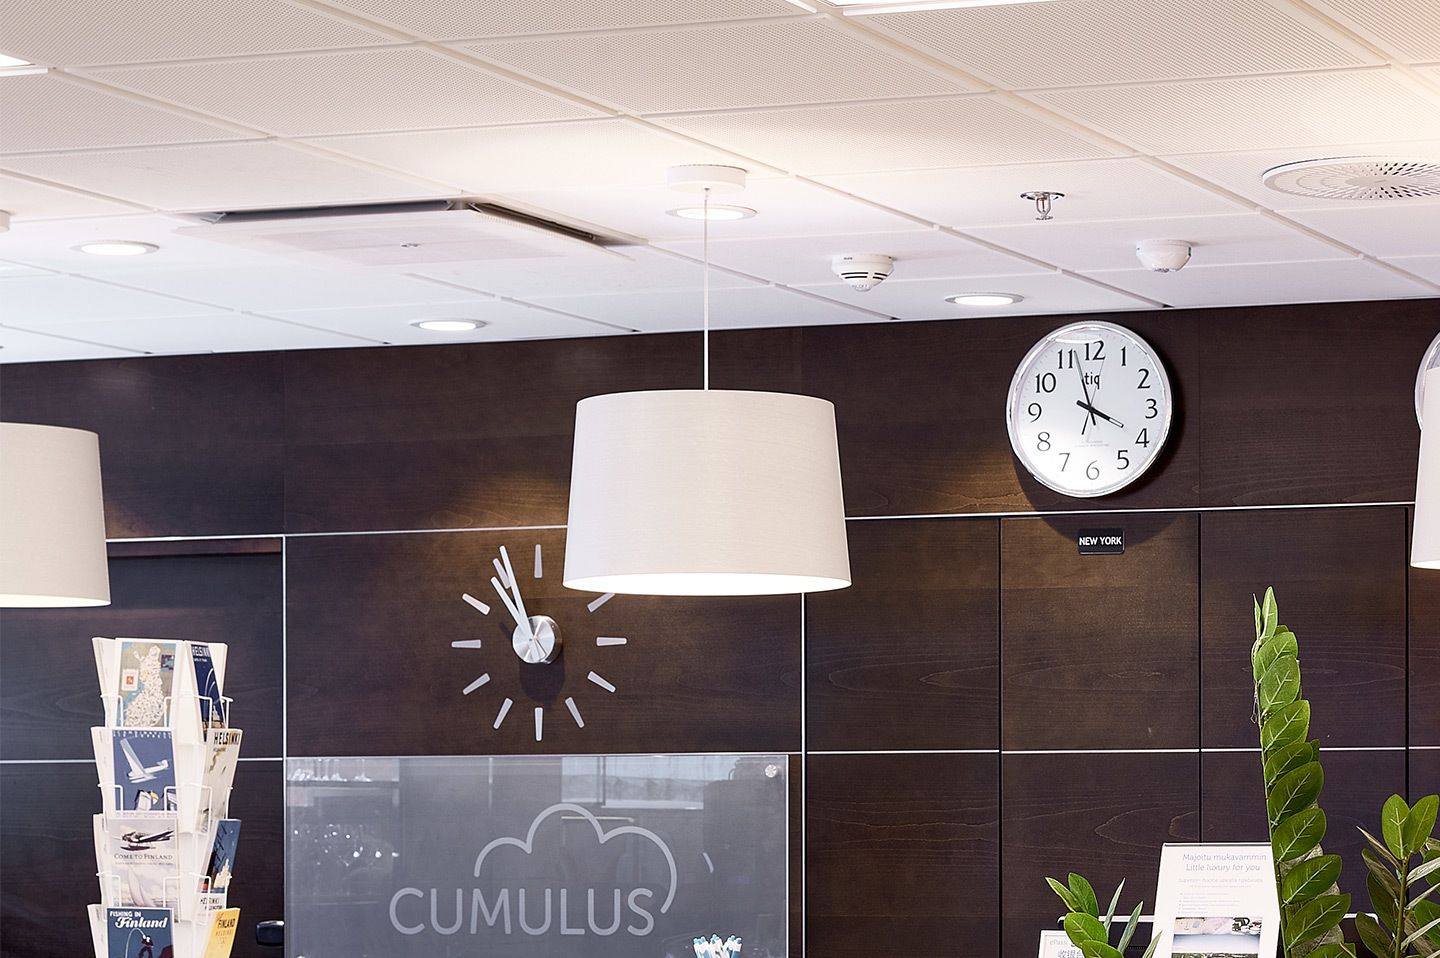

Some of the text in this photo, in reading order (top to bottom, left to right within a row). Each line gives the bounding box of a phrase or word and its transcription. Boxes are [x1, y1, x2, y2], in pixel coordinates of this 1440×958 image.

[1058, 349, 1074, 369] 11
[1084, 340, 1106, 361] 12
[1120, 346, 1127, 366] 1
[1035, 372, 1056, 393] 10
[1084, 372, 1100, 389] tiq
[1137, 368, 1151, 389] 2
[1028, 402, 1042, 423] 9
[1145, 398, 1158, 419] 3
[1037, 432, 1051, 451] 8
[1135, 428, 1149, 448] 4
[1059, 452, 1071, 472] 7
[1117, 450, 1130, 470] 5
[1086, 460, 1101, 481] 6
[1079, 537, 1122, 546] NEW YORK
[389, 887, 655, 936] CUMULUS
[115, 917, 168, 929] Finland
